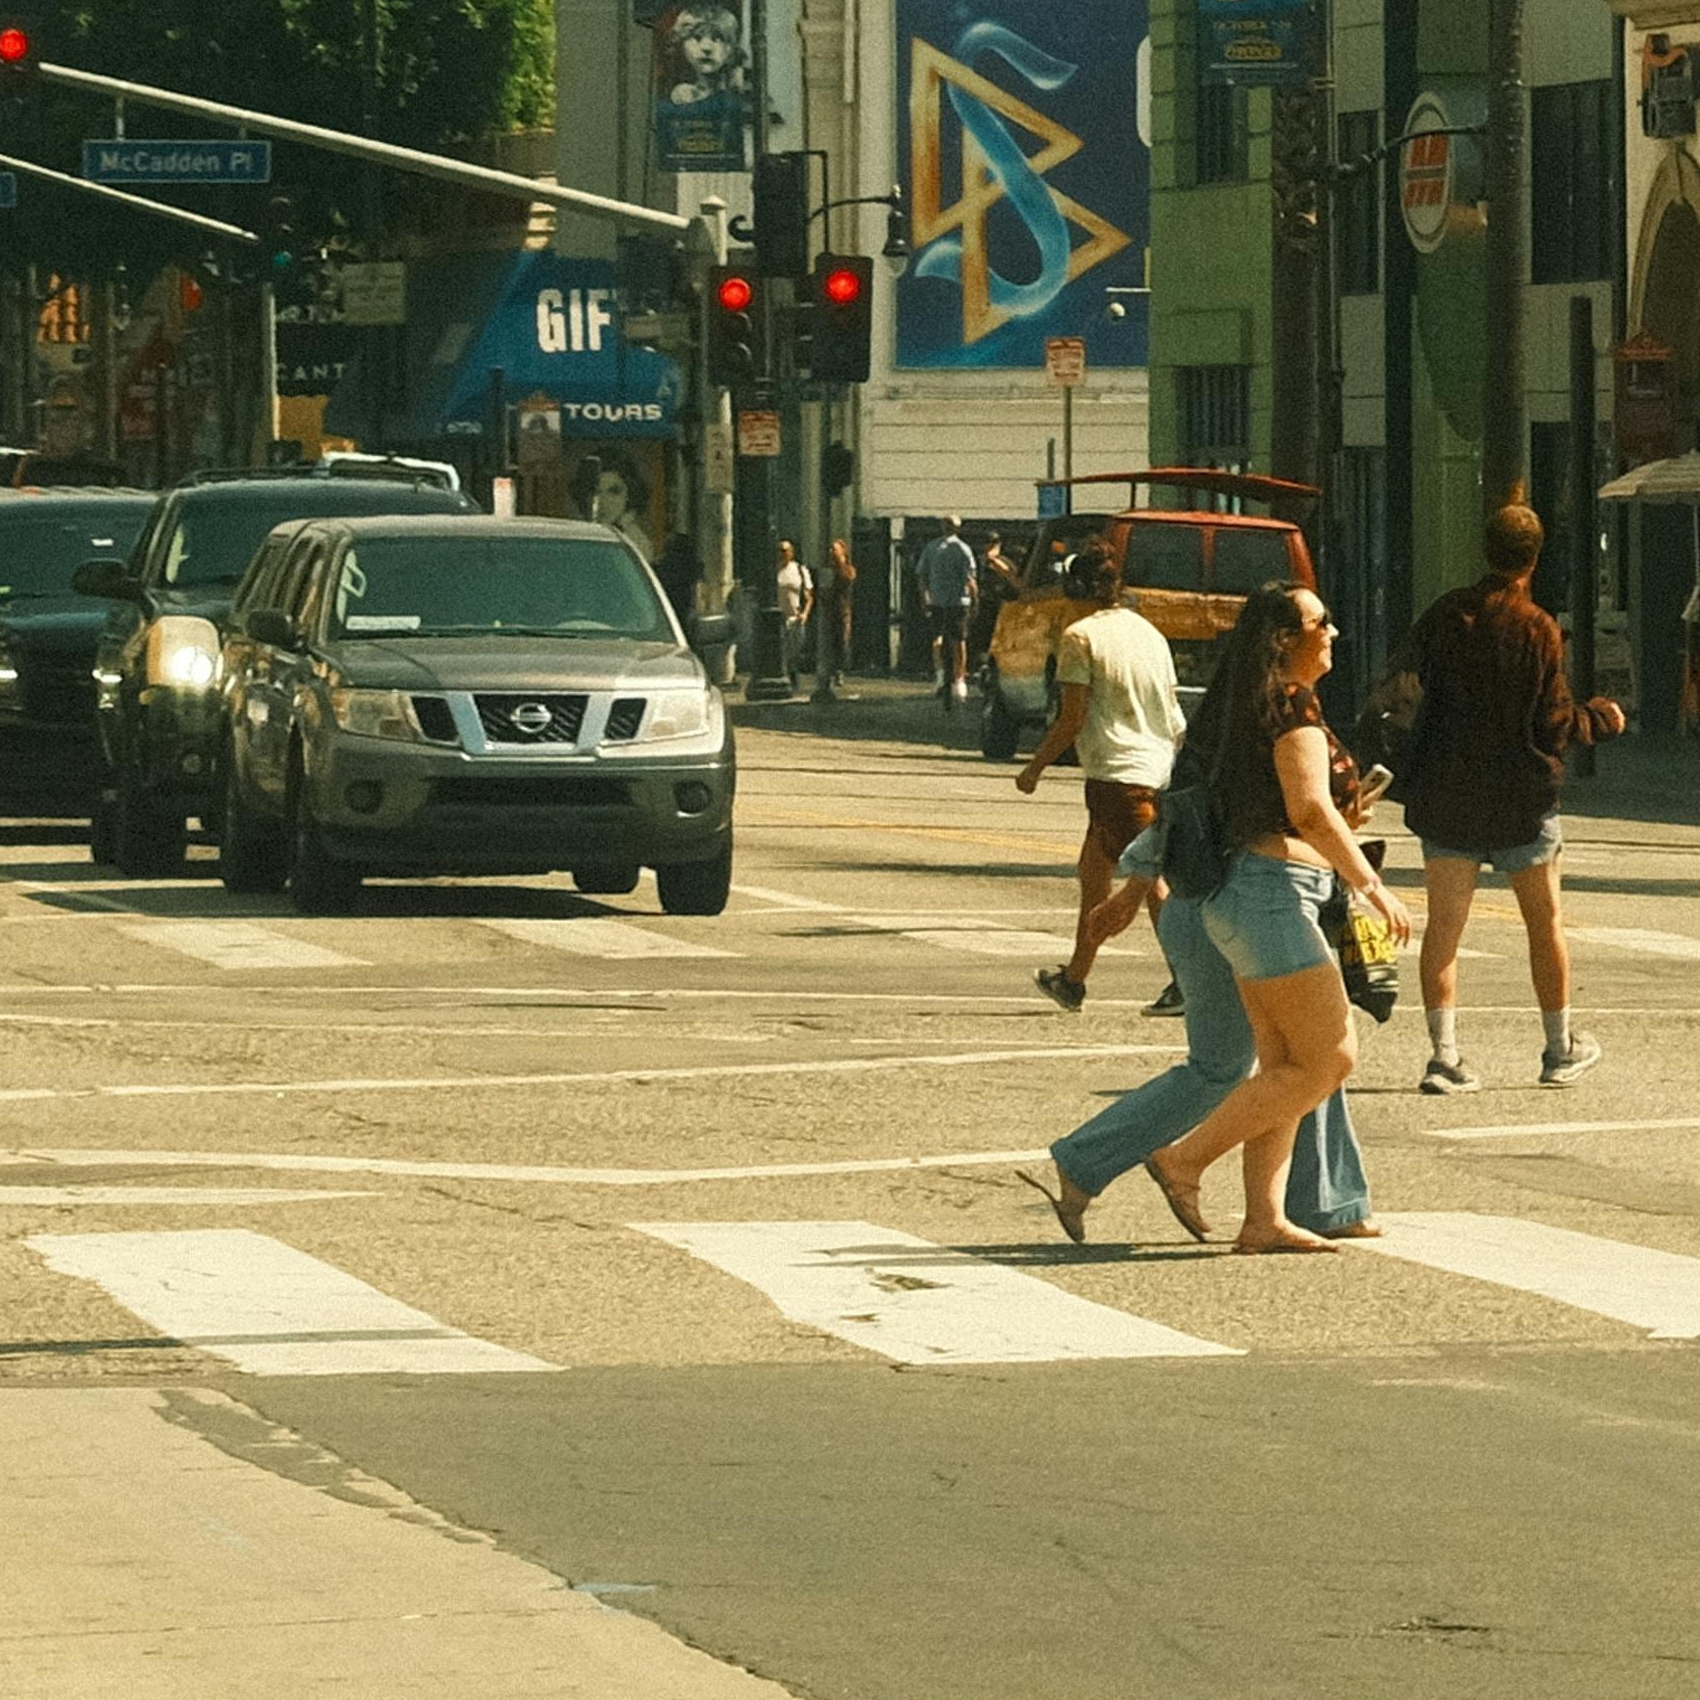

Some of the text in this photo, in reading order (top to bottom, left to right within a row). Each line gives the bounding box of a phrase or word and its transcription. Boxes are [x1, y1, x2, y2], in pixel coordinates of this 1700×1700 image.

[100, 148, 253, 173] McCadden Pl
[536, 288, 618, 352] GIF
[563, 403, 663, 421] TOURS
